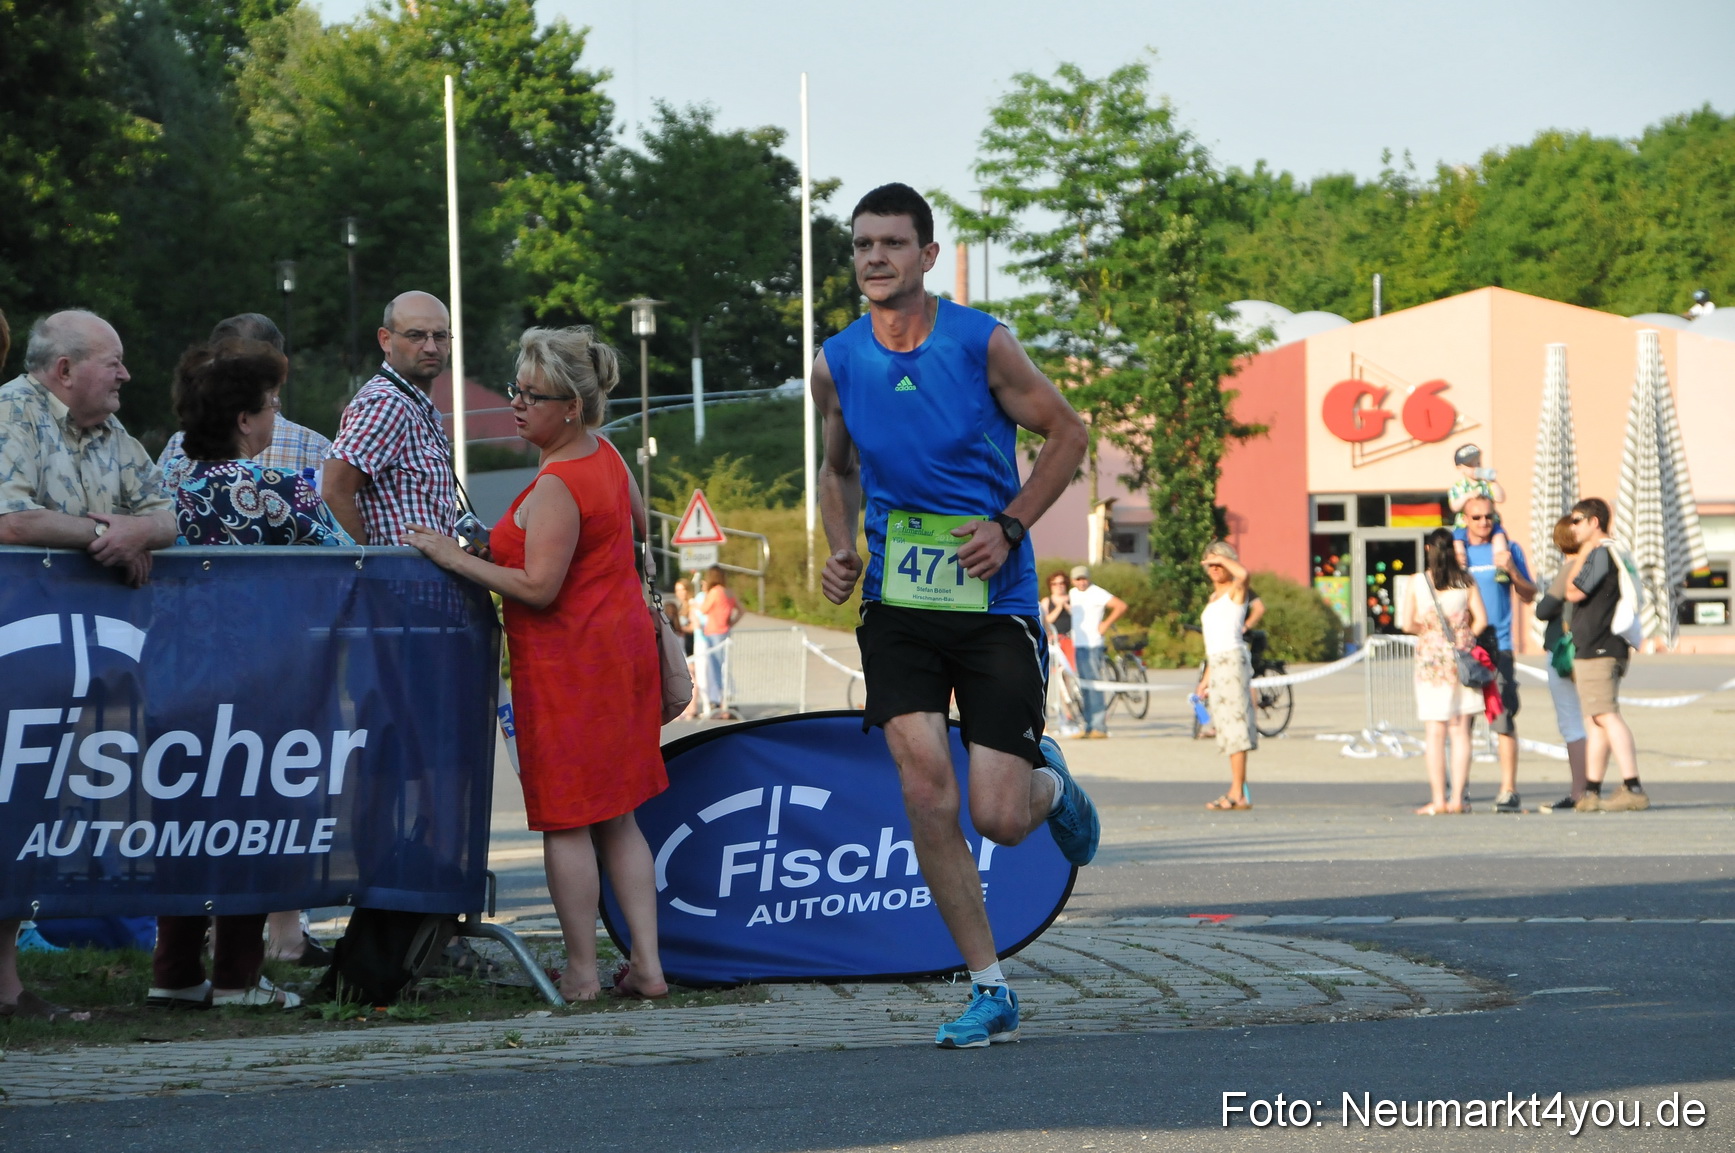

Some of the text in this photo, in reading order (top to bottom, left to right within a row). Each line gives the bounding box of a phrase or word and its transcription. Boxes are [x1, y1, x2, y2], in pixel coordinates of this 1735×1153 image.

[1322, 380, 1456, 442] G6
[897, 545, 965, 586] 471
[912, 594, 955, 602] Hirschmann-Bau
[0, 704, 368, 803] Fischer
[16, 818, 338, 861] AUTOMOBILE
[719, 827, 998, 898] Fischr
[746, 883, 988, 928] AUTOMOB
